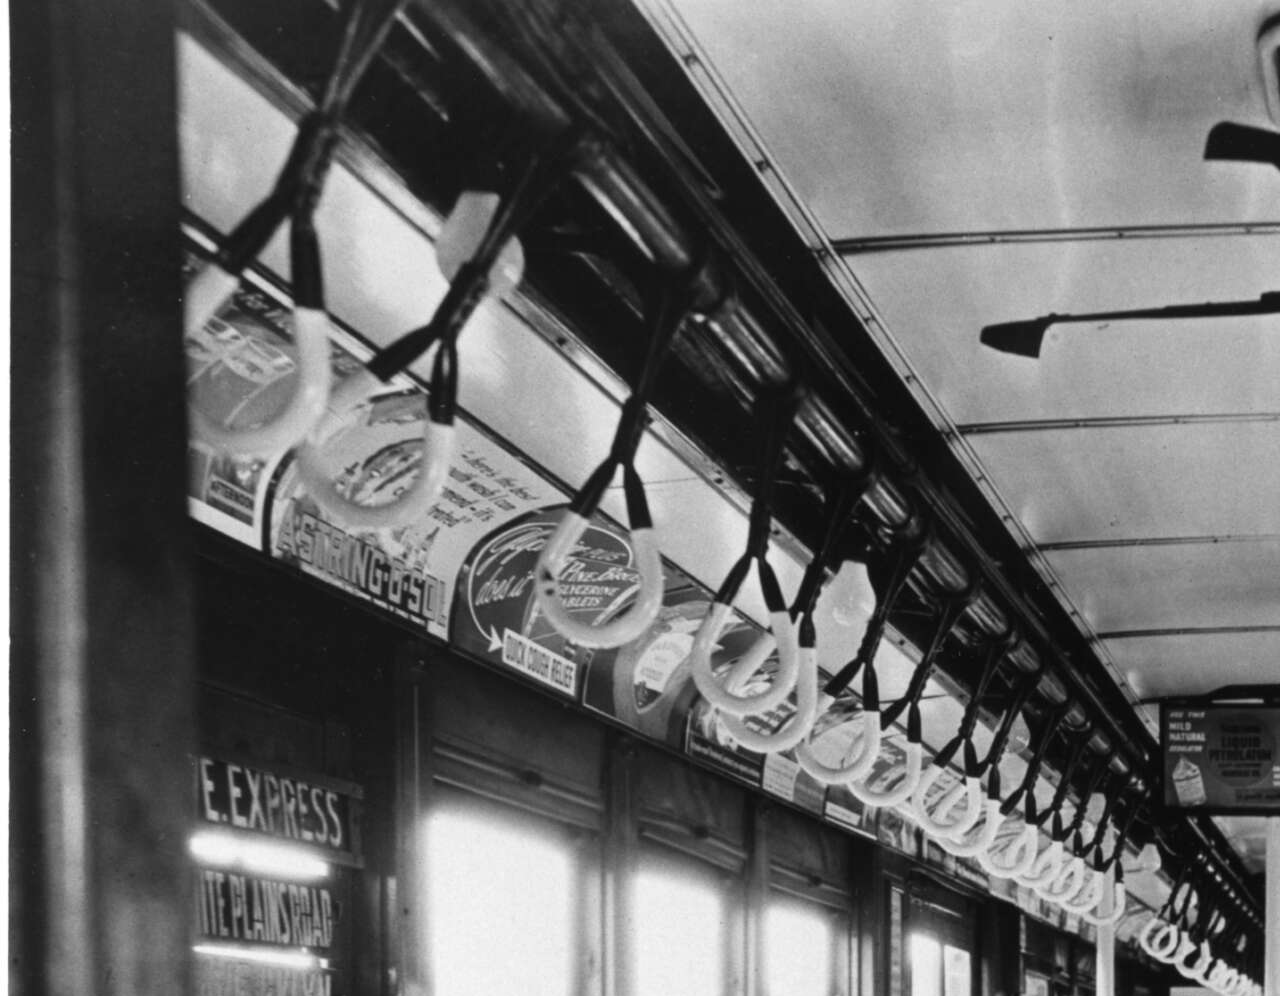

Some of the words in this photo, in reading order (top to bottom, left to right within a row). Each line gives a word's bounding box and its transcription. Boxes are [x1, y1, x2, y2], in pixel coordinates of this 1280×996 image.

[551, 656, 574, 689] RELIEF
[1169, 722, 1192, 731] MILD
[1220, 736, 1261, 750] LIQUID
